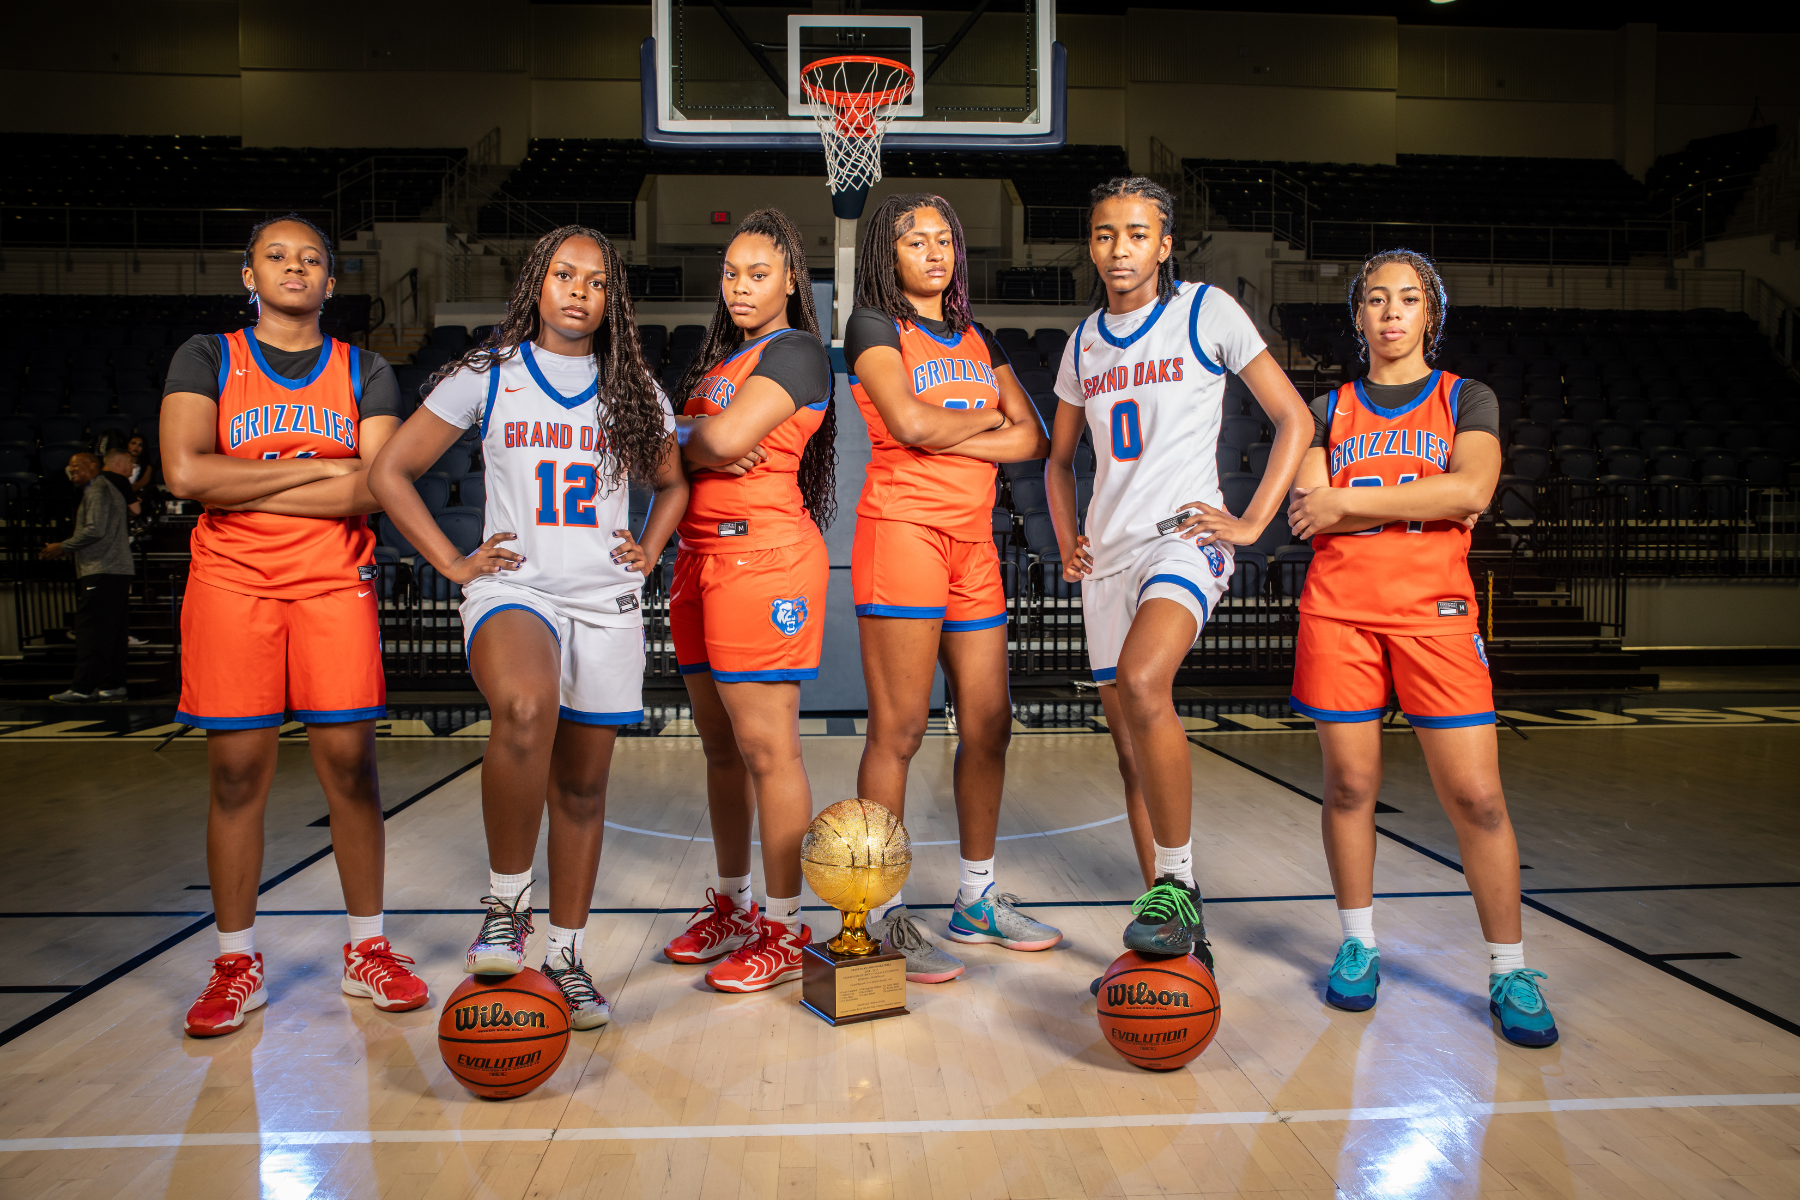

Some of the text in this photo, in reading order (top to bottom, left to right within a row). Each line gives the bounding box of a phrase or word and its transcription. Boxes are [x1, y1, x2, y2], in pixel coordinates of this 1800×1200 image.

[912, 357, 999, 399] GRIZZLIE
[1083, 357, 1184, 400] GRAND OAKS
[229, 403, 355, 450] GRIZZLIES
[504, 420, 616, 453] GRAND OA
[1109, 398, 1144, 462] 0
[1330, 429, 1449, 478] GRIZZLIES
[535, 459, 600, 528] 12
[1106, 981, 1190, 1008] Wilson
[454, 1001, 546, 1032] Wilson
[1111, 1027, 1188, 1044] EVOLUTION
[457, 1050, 542, 1069] EVOLUTION
